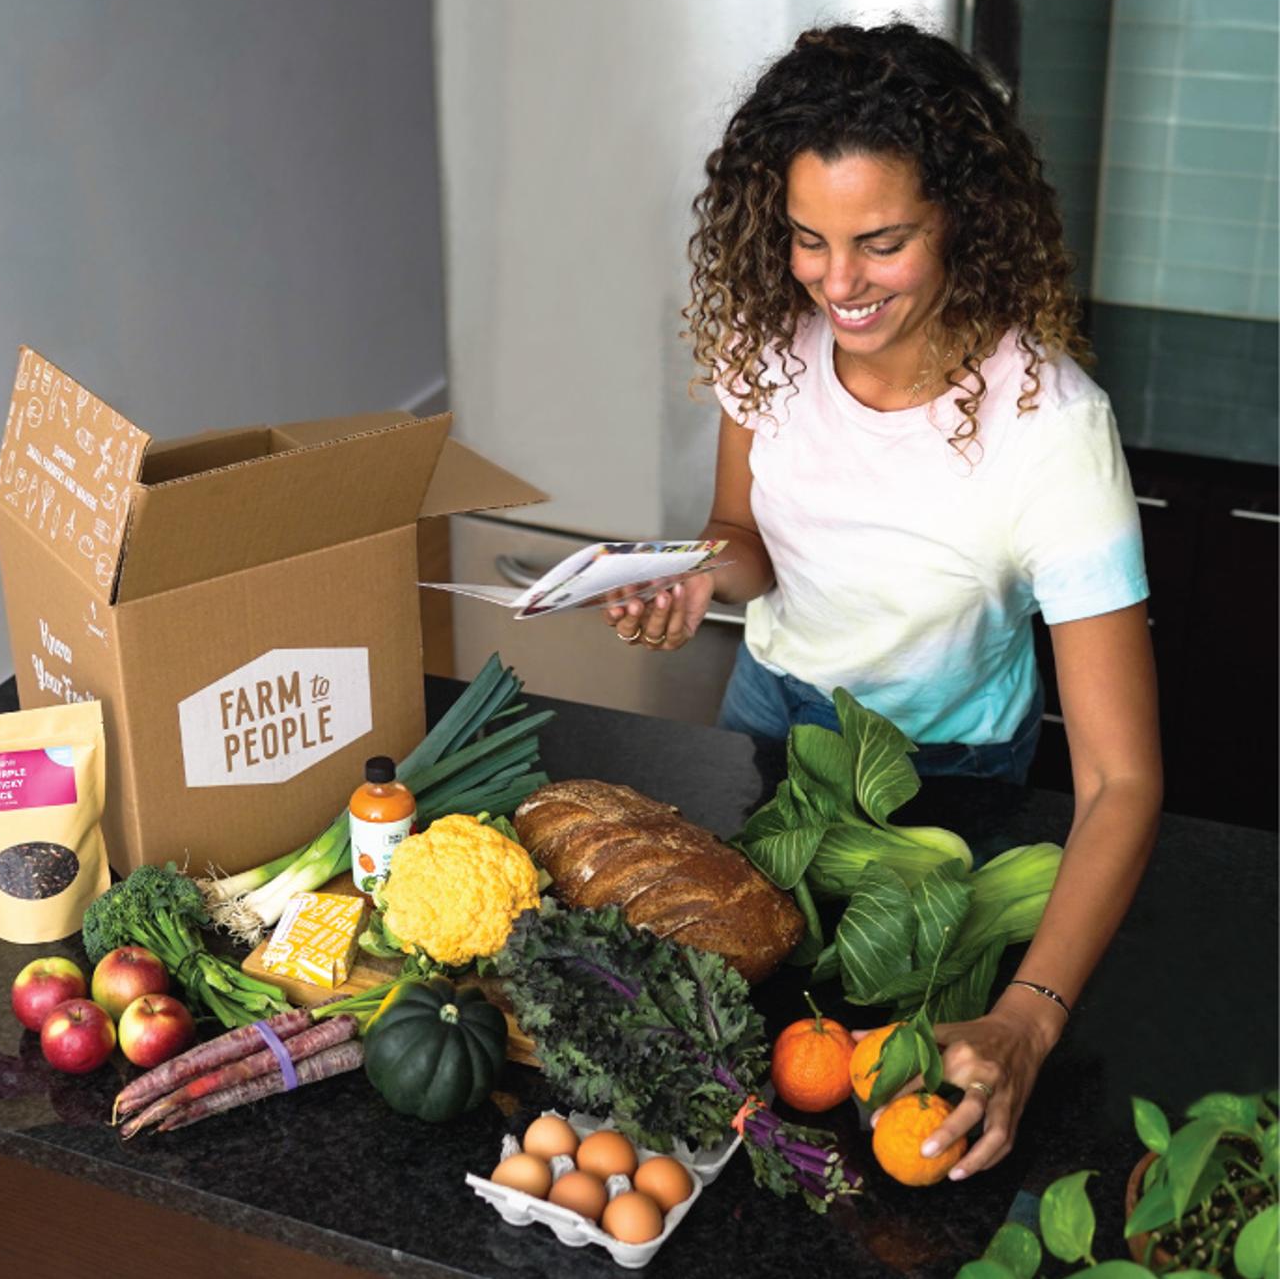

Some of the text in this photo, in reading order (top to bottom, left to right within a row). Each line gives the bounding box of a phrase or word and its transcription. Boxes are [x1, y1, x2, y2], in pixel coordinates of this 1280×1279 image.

[219, 670, 331, 731] FARM to
[223, 704, 334, 773] PEOPLE
